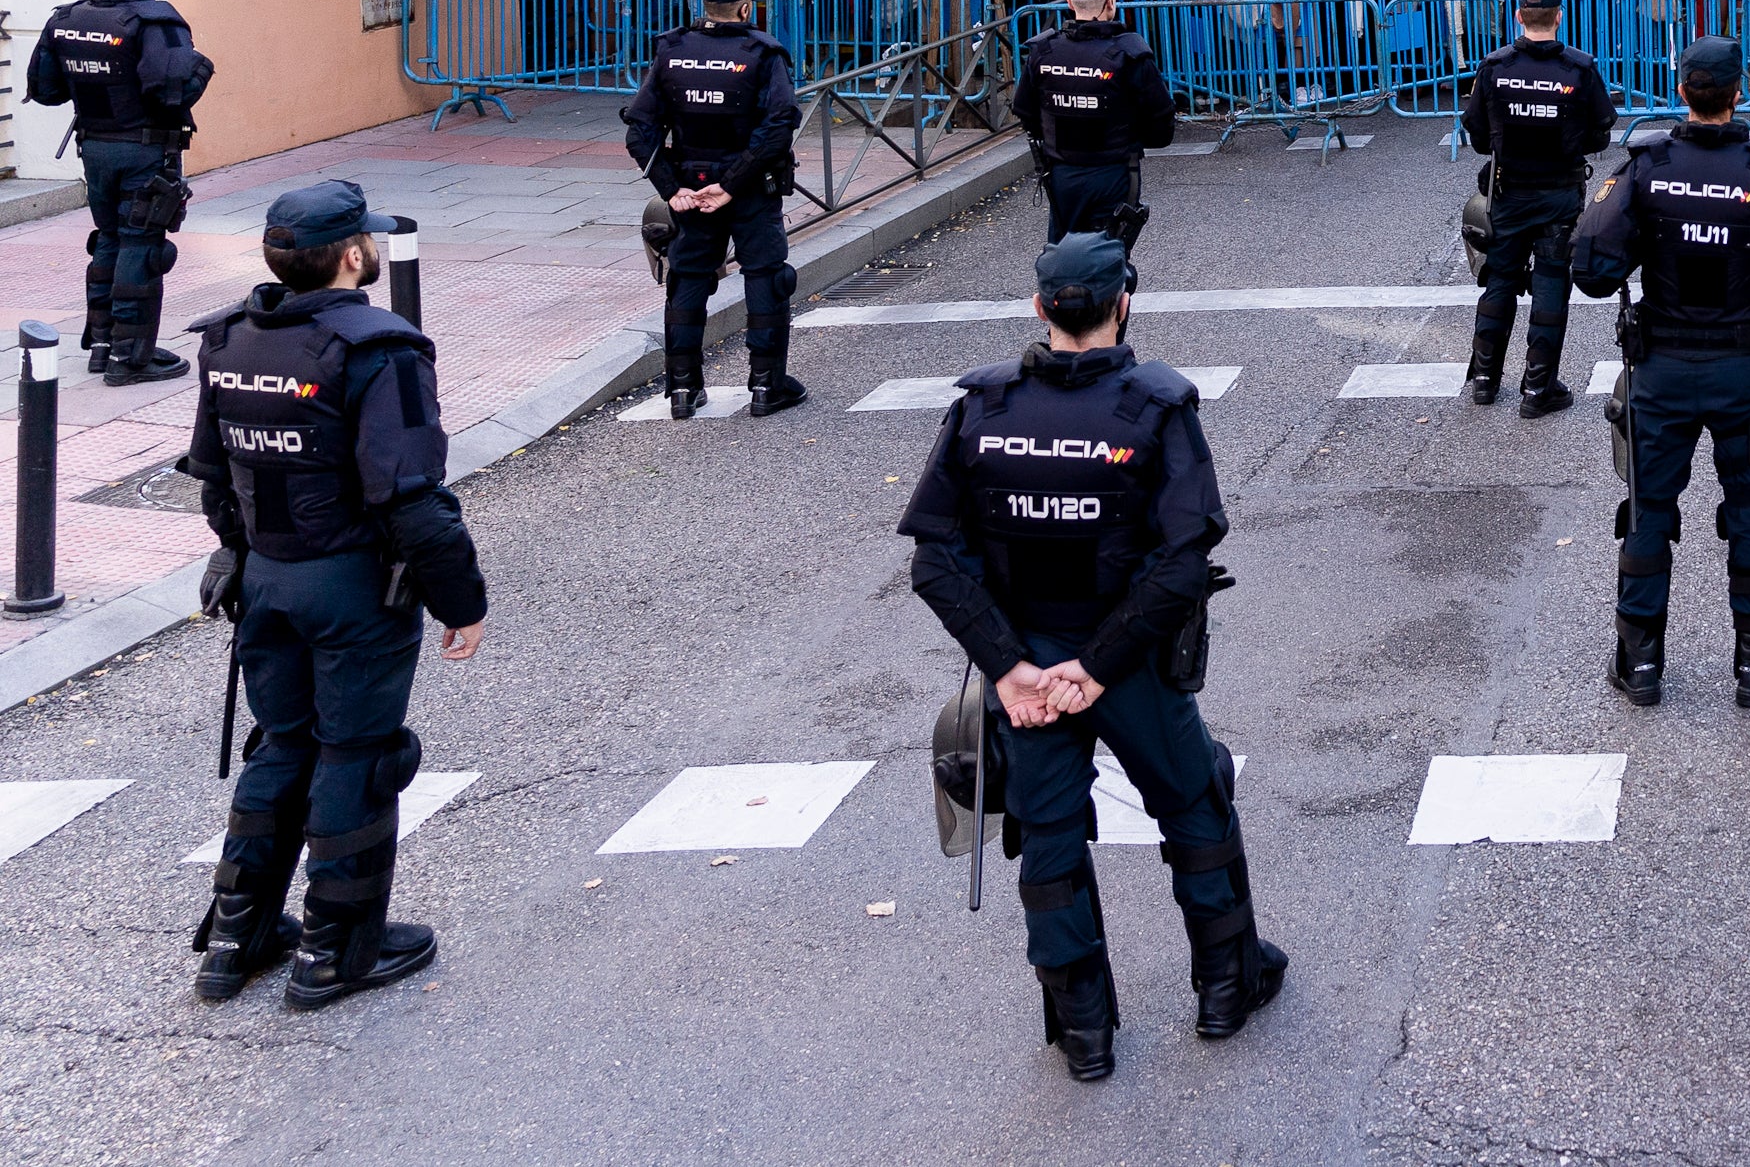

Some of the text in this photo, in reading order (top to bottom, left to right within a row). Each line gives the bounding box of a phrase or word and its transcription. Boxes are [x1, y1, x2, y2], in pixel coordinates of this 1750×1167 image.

[54, 28, 114, 43] POLICIA
[669, 59, 736, 71] POLICIA
[1040, 65, 1103, 78] POLICIA
[1496, 78, 1563, 92] POLICIA
[685, 89, 725, 104] 11U13
[1052, 93, 1099, 109] 11U133
[1508, 103, 1558, 118] 11U135
[1650, 180, 1746, 200] POLICIA
[1681, 222, 1729, 245] 11U11
[208, 370, 301, 394] POLICIA
[228, 426, 303, 453] 11U140
[978, 435, 1113, 459] POLICIA
[1007, 494, 1101, 520] 11U120
